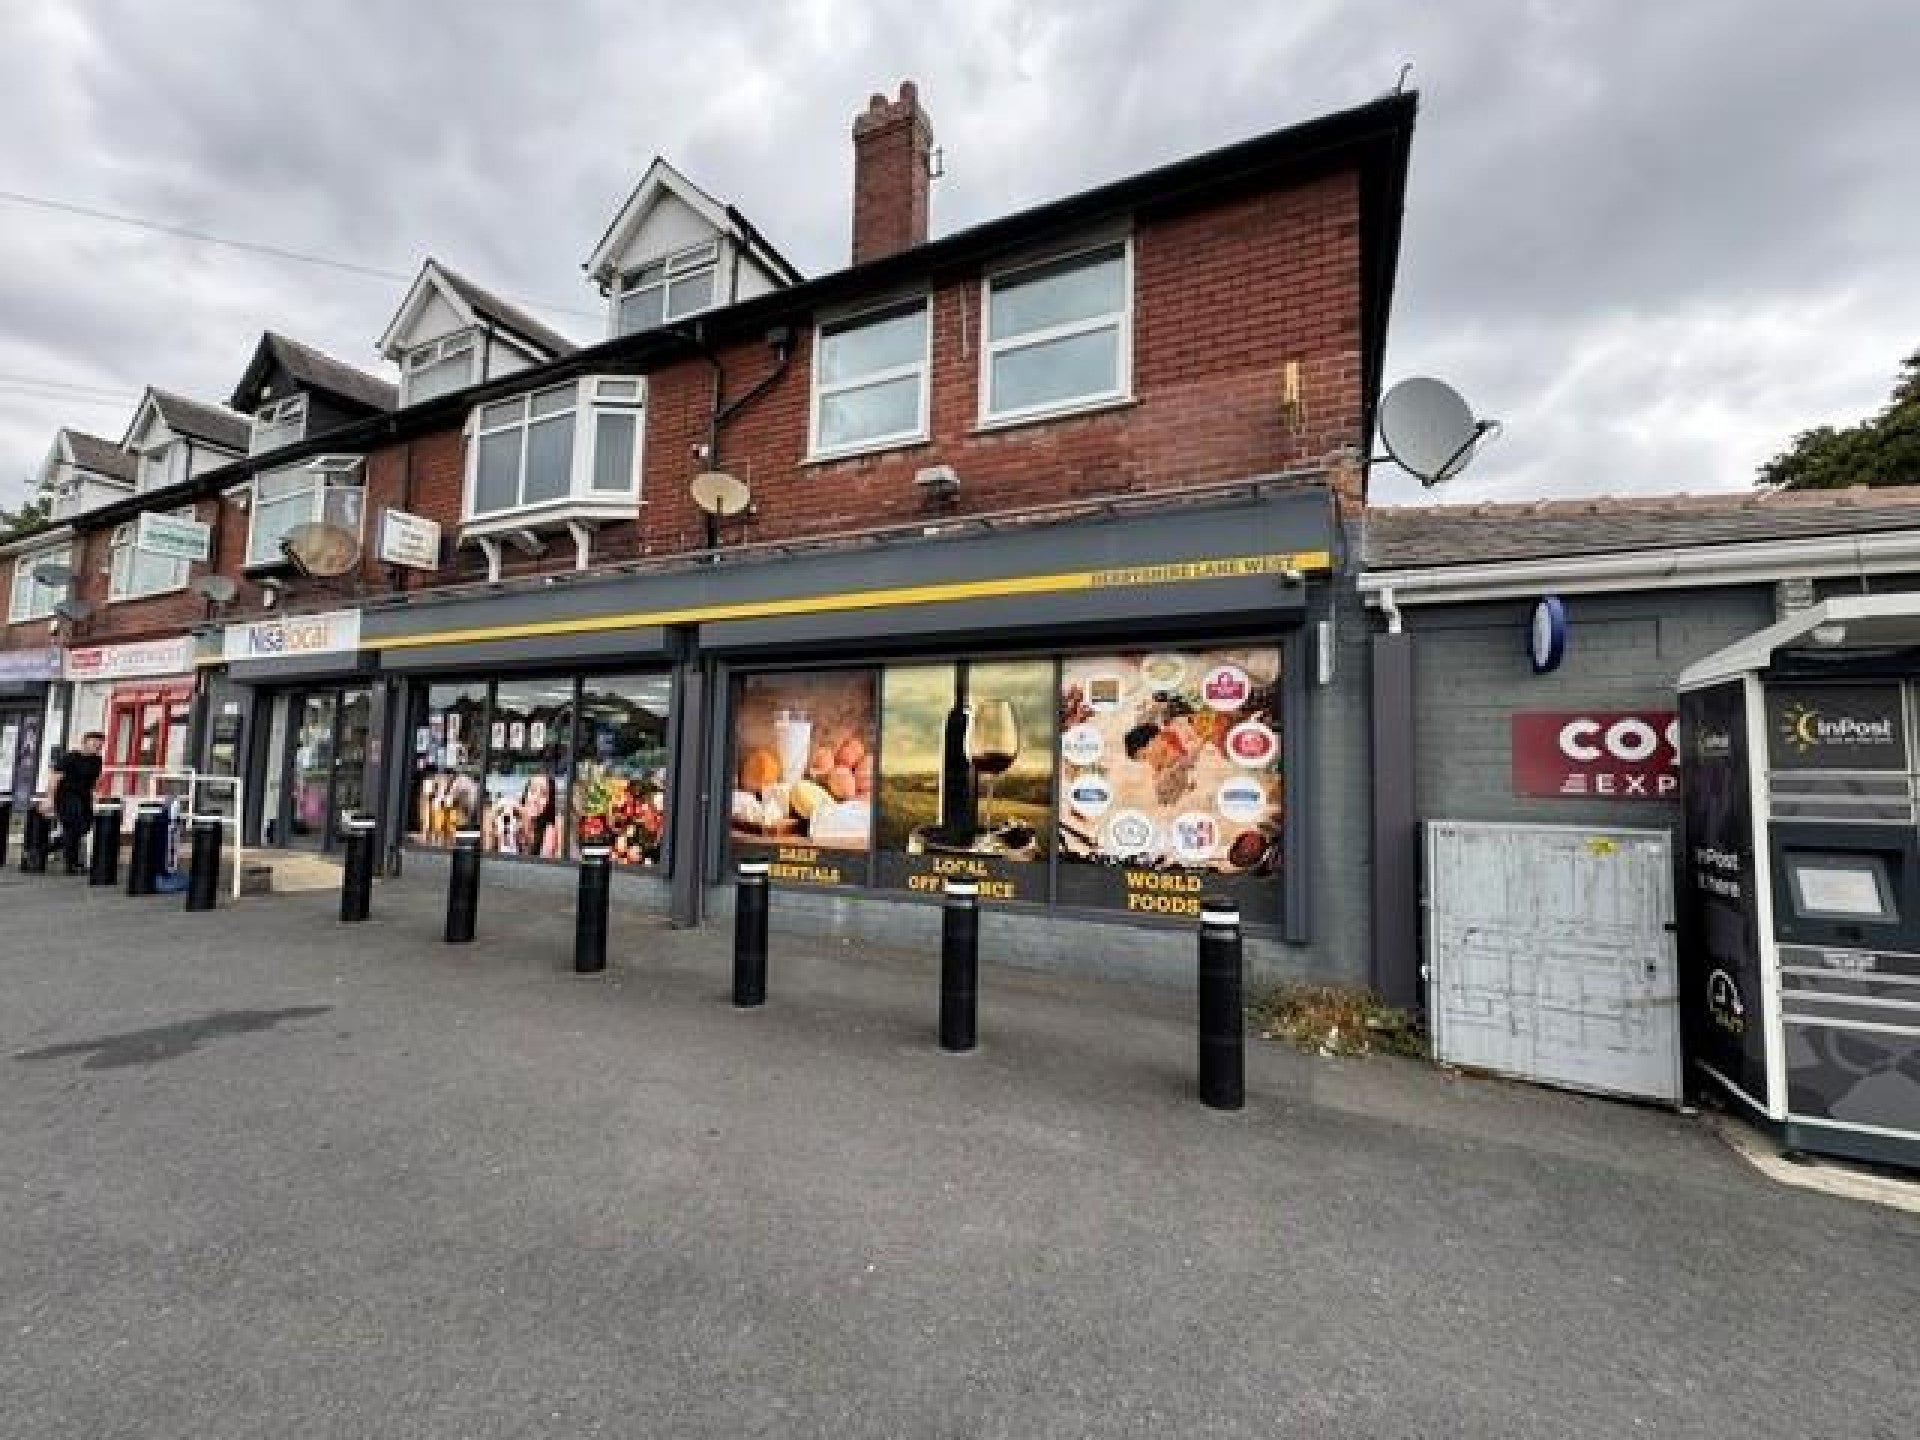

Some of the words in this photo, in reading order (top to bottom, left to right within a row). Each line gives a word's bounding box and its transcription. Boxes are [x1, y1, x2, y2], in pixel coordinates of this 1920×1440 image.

[934, 857, 988, 877] LOCAL
[908, 875, 940, 892] OFF
[1127, 872, 1201, 891] WORLD
[1129, 893, 1201, 915] FOODS
